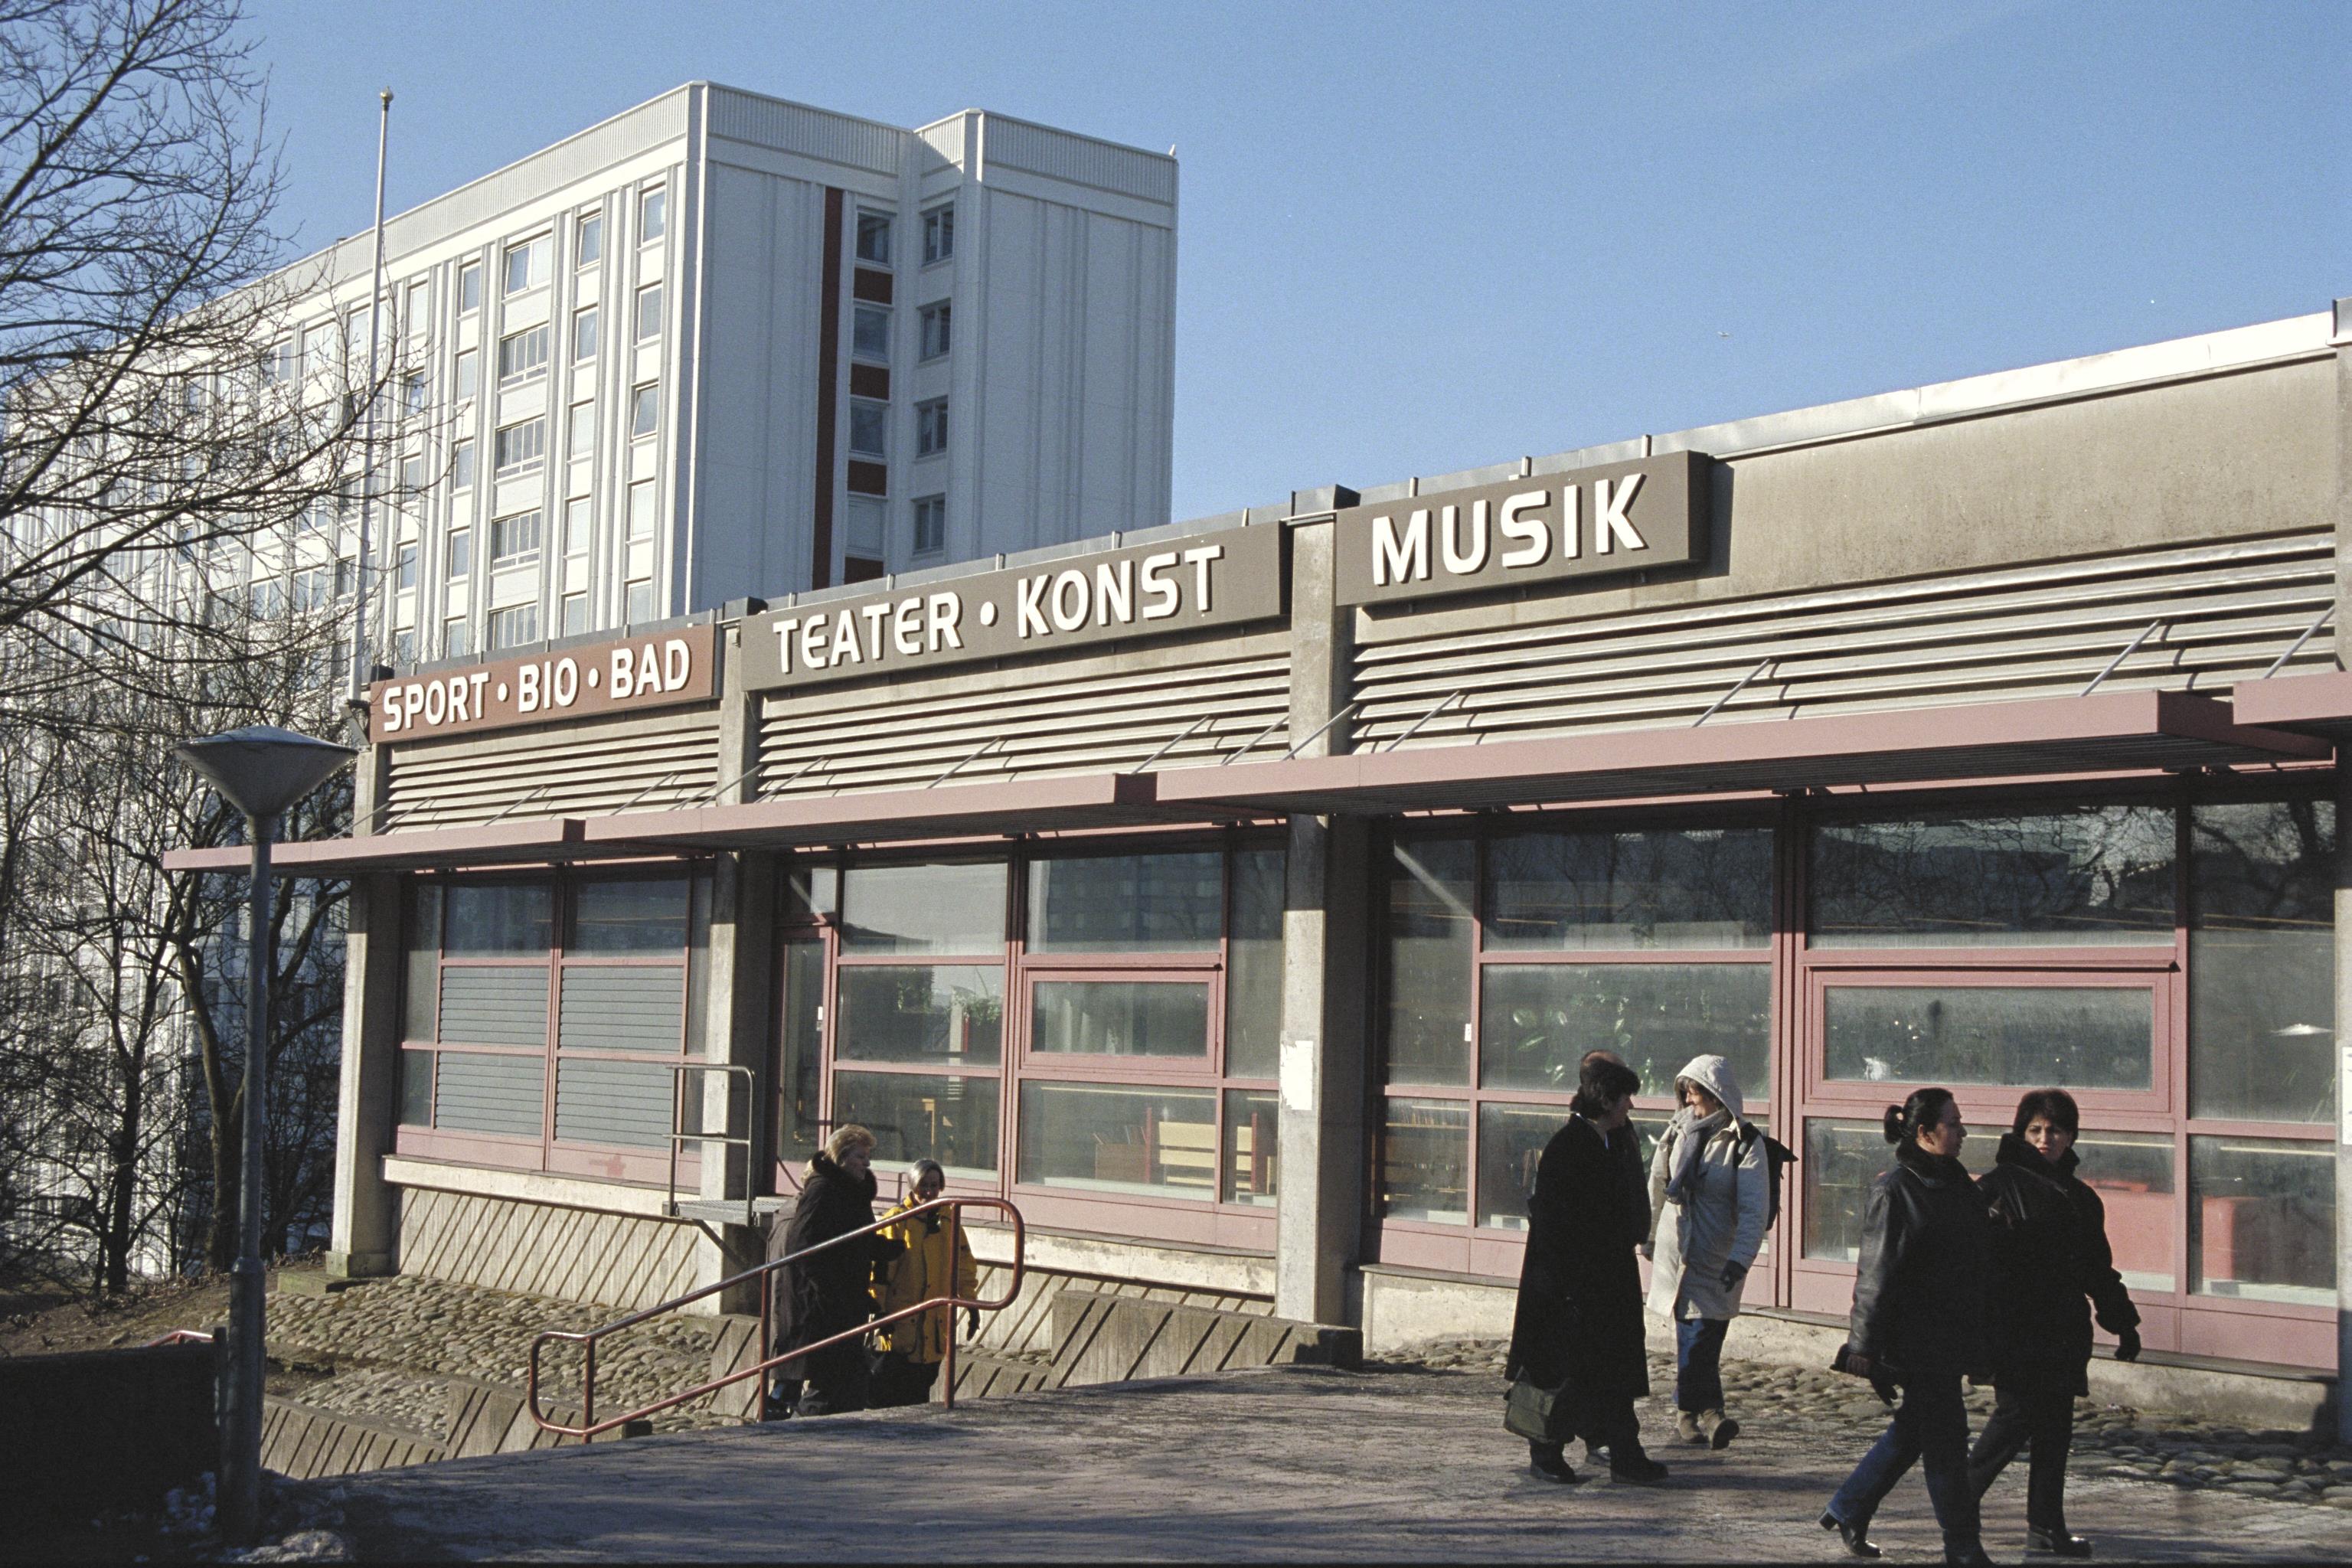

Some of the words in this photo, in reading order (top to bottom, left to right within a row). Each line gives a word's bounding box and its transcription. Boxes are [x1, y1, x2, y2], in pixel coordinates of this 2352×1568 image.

[1371, 472, 1648, 587] MUSIK
[773, 590, 963, 675] TEATER
[1017, 544, 1223, 639] KONST
[383, 671, 491, 733] SPORT
[518, 656, 579, 714] BIO
[609, 638, 691, 701] BAD
